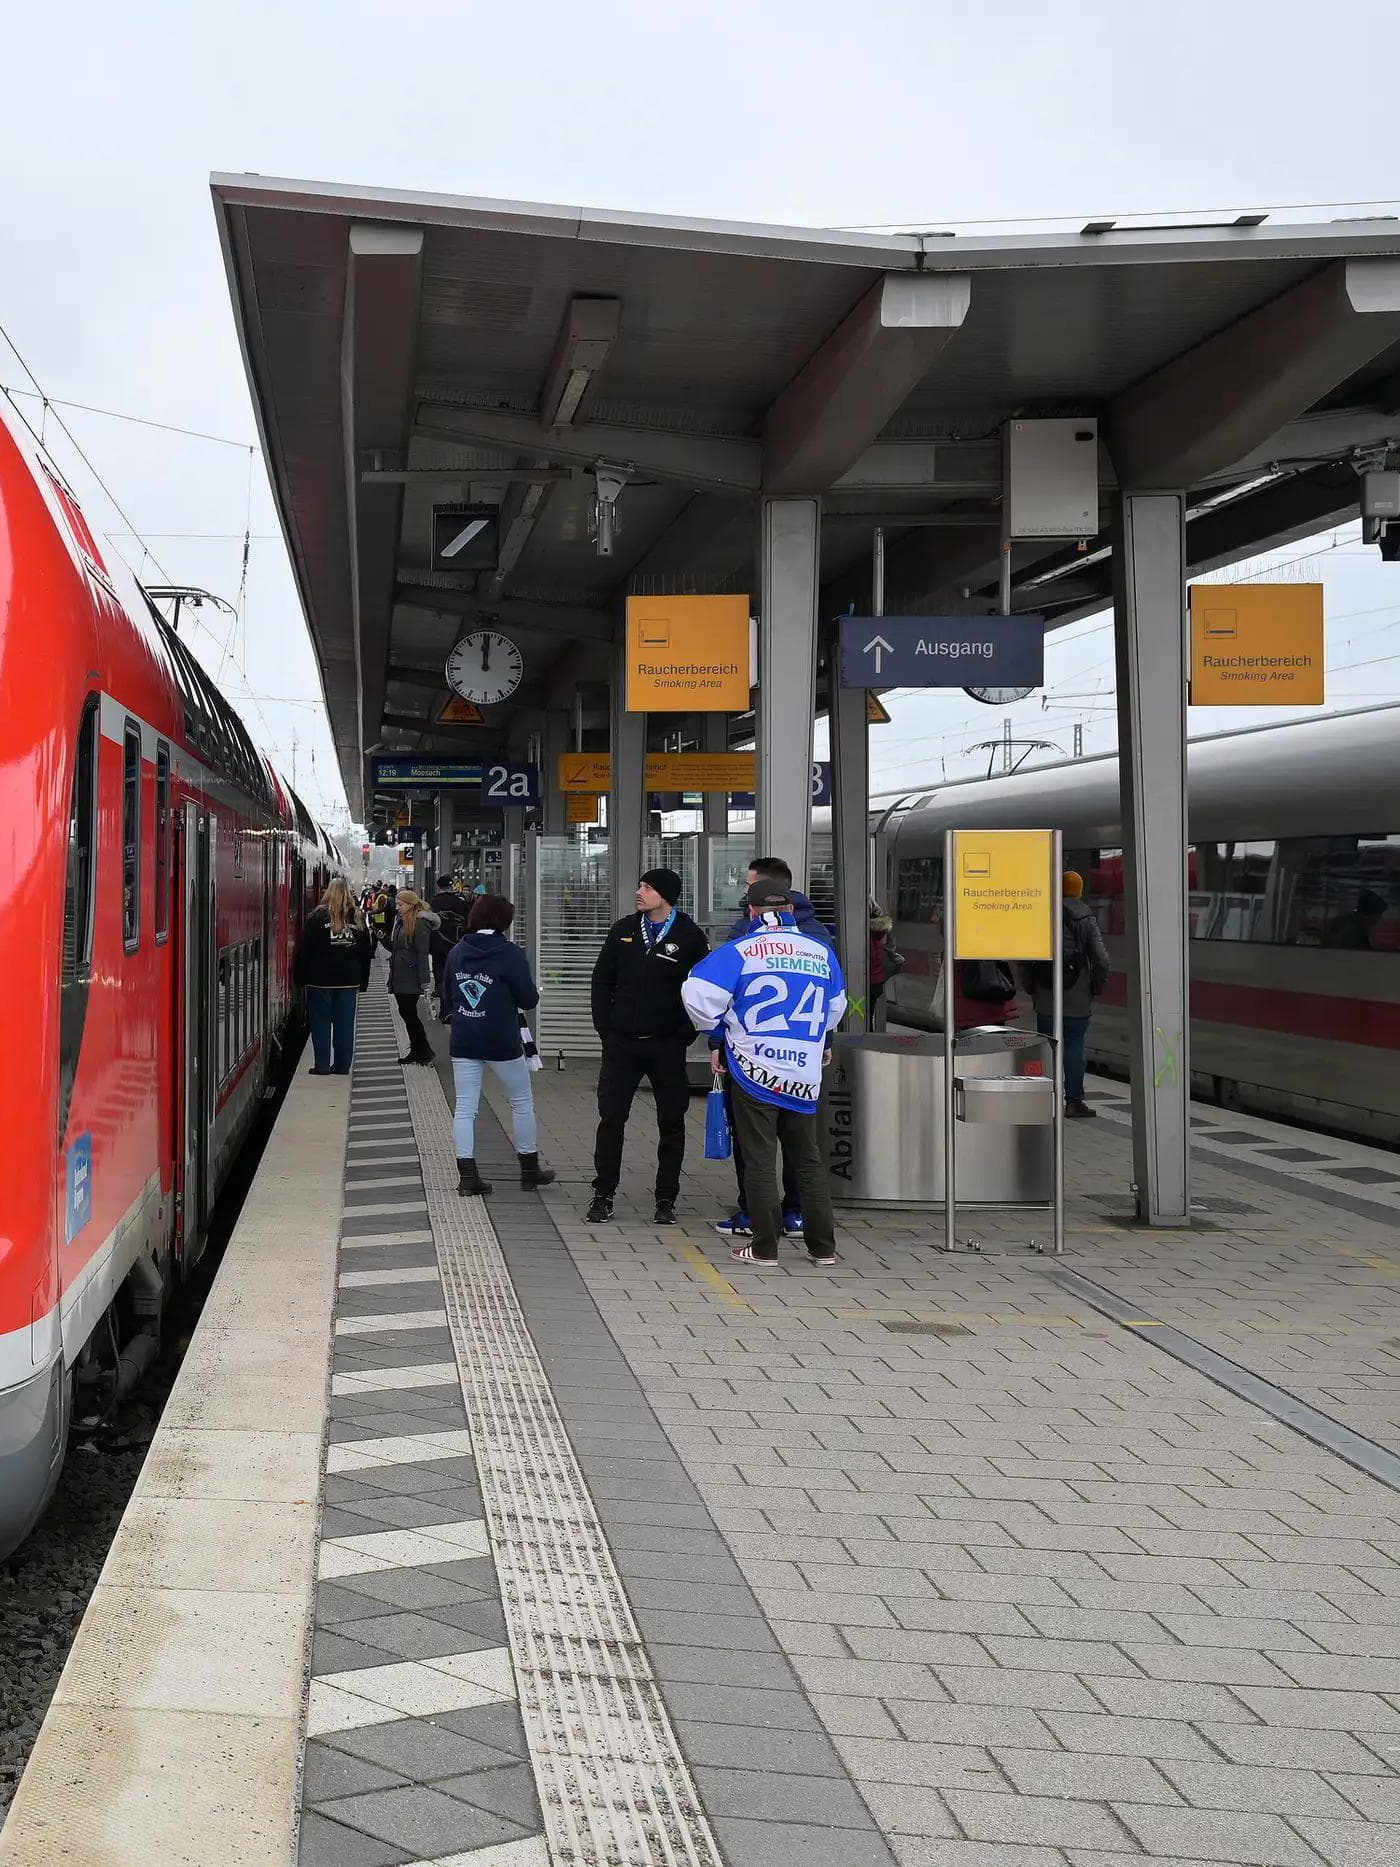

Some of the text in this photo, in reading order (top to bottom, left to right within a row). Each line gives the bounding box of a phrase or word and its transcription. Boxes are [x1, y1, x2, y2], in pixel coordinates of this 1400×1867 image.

[915, 639, 993, 658] Ausgang
[1203, 655, 1312, 667] Raucherbereich
[638, 664, 738, 675] Raucherbereich
[1220, 671, 1295, 682] Smoking Area
[653, 679, 722, 689] Smoking Area
[488, 766, 530, 797] 2a
[963, 888, 1042, 898] Raucherbereich
[972, 902, 1033, 912] Smoking Area
[743, 942, 794, 960] FUJITSU
[765, 957, 828, 976] SIEMENS
[457, 1005, 486, 1018] Panther
[743, 974, 825, 1037] 24
[754, 1043, 809, 1068] Young
[828, 1091, 852, 1181] Abfall
